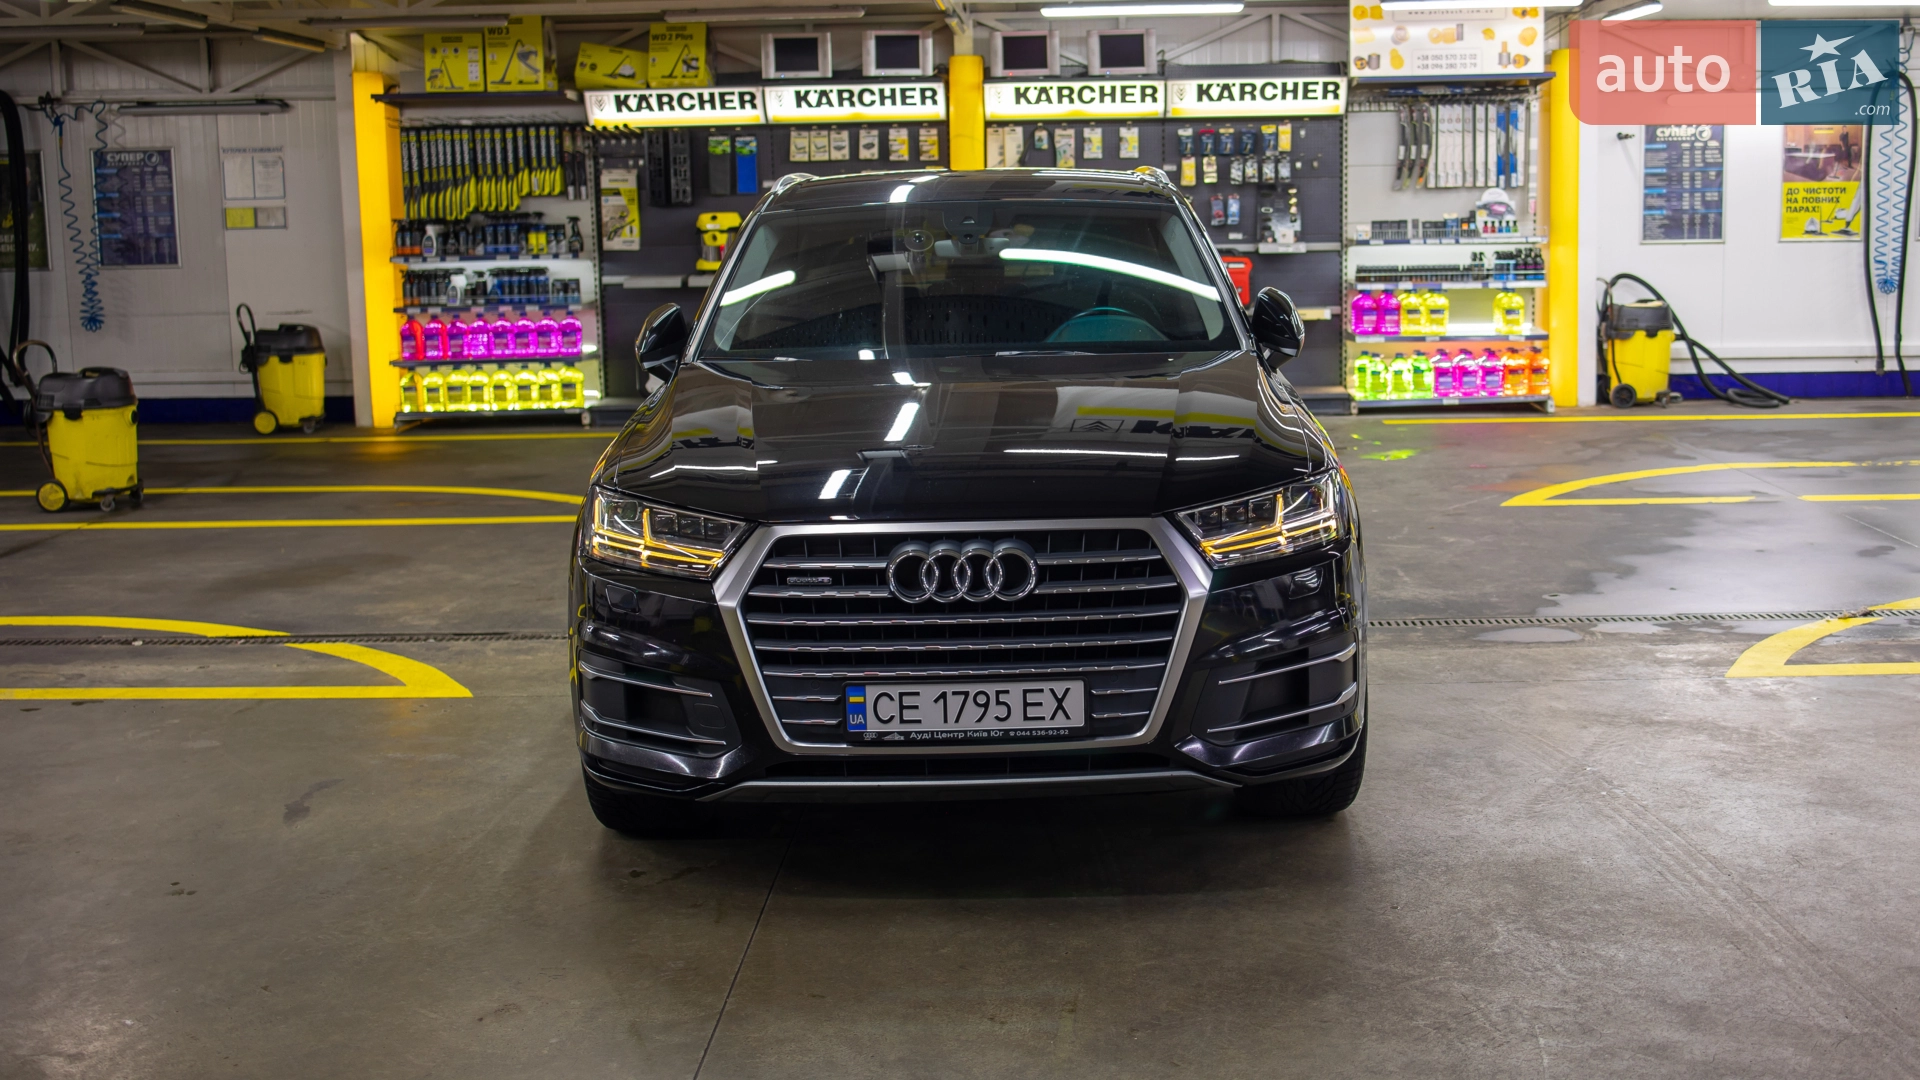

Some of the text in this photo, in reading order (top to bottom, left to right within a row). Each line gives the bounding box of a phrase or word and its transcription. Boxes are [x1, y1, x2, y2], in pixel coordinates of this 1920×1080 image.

[487, 27, 510, 35] WD 3
[1014, 85, 1158, 105] KÄRCHER
[1196, 81, 1340, 102] KÄRCHER
[614, 91, 758, 112] KÄRCHER
[795, 88, 938, 108] KÄRCHER
[1656, 127, 1696, 137] СУПЕР
[107, 153, 144, 162] СУПЕР
[1786, 187, 1846, 196] ДО ЧИСТОТИ
[1786, 196, 1840, 204] НА ПОВНИХ
[1786, 205, 1820, 213] ПАРАХ!
[873, 687, 1072, 724] CE 1795 EX
[850, 714, 865, 724] UA
[910, 732, 931, 740] Ауді
[934, 731, 965, 739] Центр
